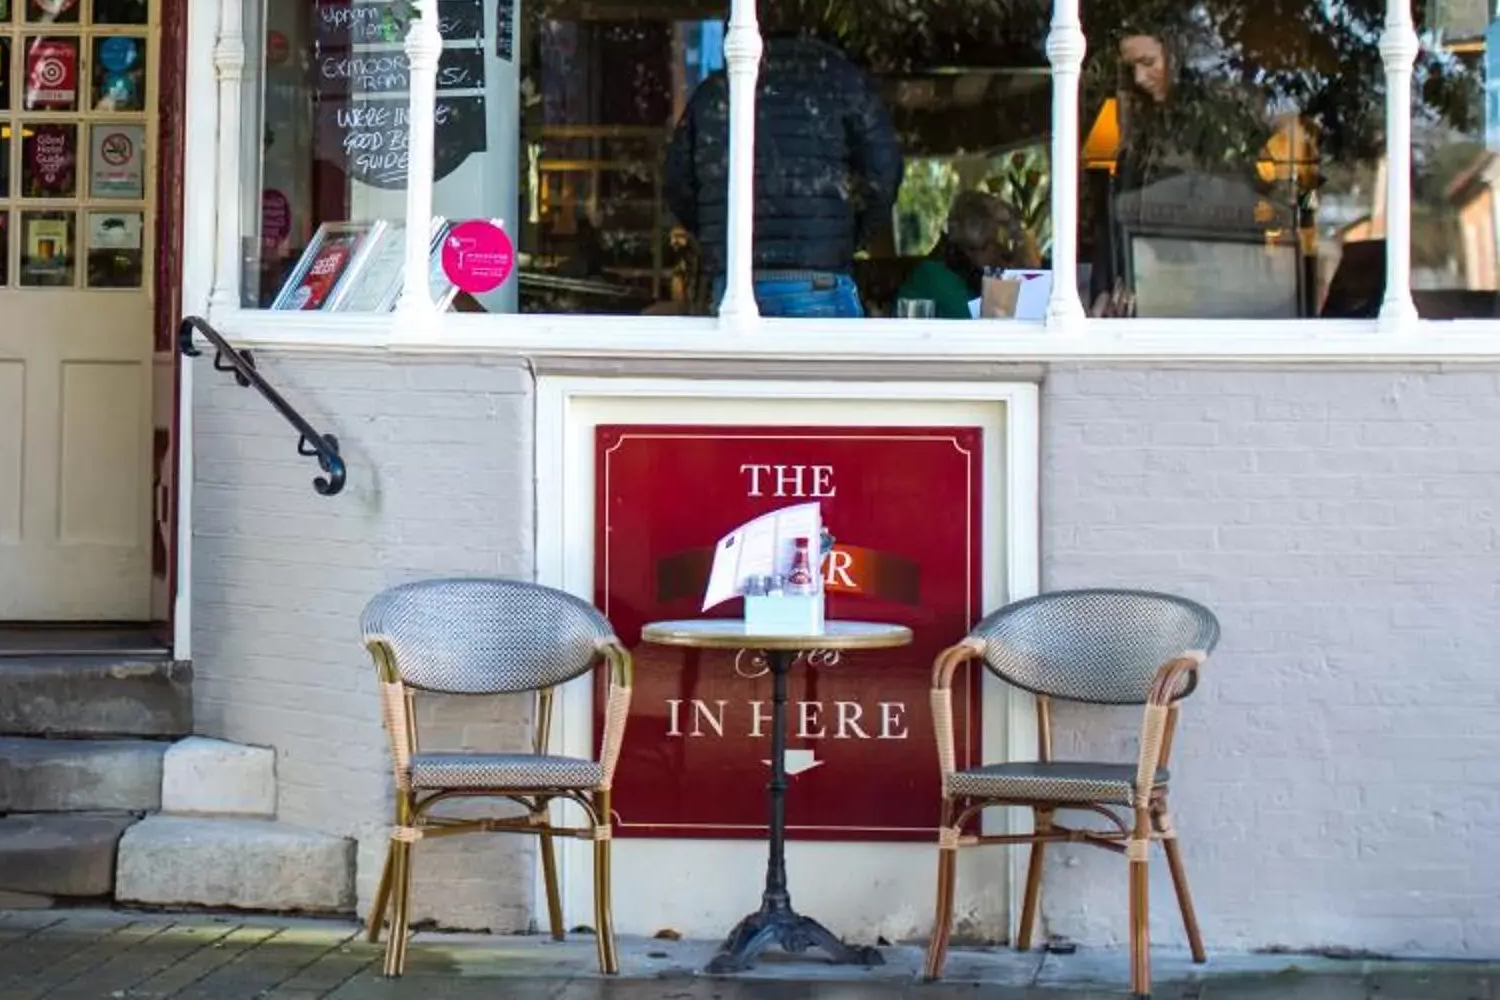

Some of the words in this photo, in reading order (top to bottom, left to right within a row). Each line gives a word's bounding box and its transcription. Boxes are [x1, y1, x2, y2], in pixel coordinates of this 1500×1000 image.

[344, 131, 383, 154] GOOD
[740, 464, 836, 497] THE
[665, 699, 726, 738] IN
